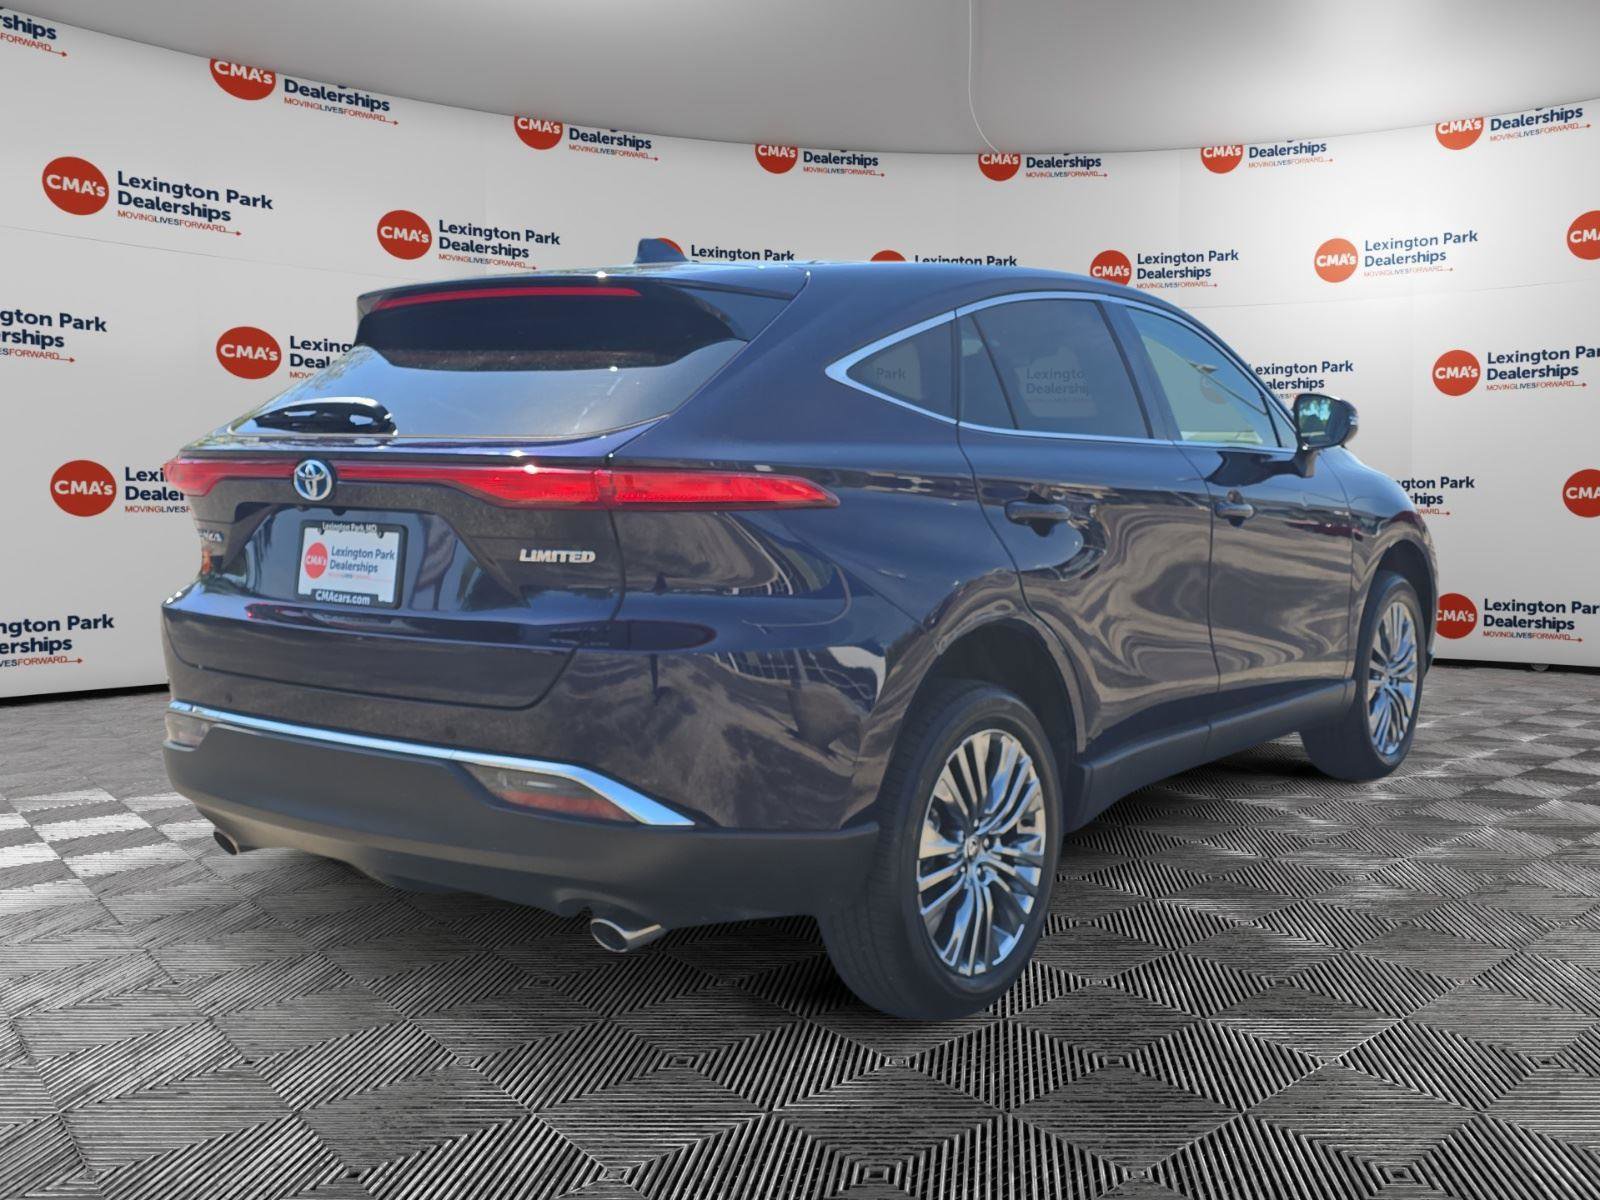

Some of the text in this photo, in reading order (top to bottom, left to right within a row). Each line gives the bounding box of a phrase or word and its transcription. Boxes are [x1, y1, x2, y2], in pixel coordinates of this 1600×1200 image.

[0, 14, 57, 40] ships
[213, 60, 273, 85] CMA's
[284, 78, 390, 112] Dealerships
[284, 97, 386, 122] MOVINGLIVESFORWARD
[517, 117, 560, 134] CMA's
[1437, 119, 1482, 135] CMA's
[1490, 107, 1583, 131] Dealerships
[569, 127, 652, 151] Dealerships
[1490, 122, 1580, 142] MOVINGLIVESFORWARD
[757, 145, 796, 158] CMA's
[1202, 145, 1242, 159] CMA's
[1248, 141, 1328, 159] Dealerships
[803, 151, 879, 168] Dealerships
[980, 153, 1019, 165] CMA's
[1026, 156, 1102, 170] Dealerships
[46, 174, 106, 197] CMA's
[117, 171, 273, 209] Lexington Park
[117, 190, 231, 222] Dealerships
[117, 210, 226, 233] MOVINGLIVESFORWARD
[380, 226, 430, 244] CMA's
[439, 219, 561, 245] Lexington Park
[1364, 230, 1478, 251] Lexington Park
[439, 236, 529, 260] Dealerships
[691, 244, 795, 261] Lexington Park
[438, 253, 526, 268] MOVINGLIVESFORWARD
[987, 255, 1017, 266] Park
[1137, 249, 1239, 266] Lexington Park
[1316, 253, 1356, 267] CMA's
[1364, 250, 1446, 267] Dealerships
[1092, 265, 1130, 277] CMA's
[1137, 266, 1212, 281] Dealerships
[60, 312, 107, 332] Park
[0, 329, 65, 349] rships
[220, 343, 278, 361] CMA's
[1487, 350, 1570, 365] Lexington
[876, 367, 907, 380] Park
[1322, 360, 1354, 373] Park
[1435, 365, 1479, 380] CMA's
[1486, 365, 1579, 380] Dealerships
[1486, 380, 1575, 391] MOVINGLIVESFORWARD
[125, 466, 168, 482] Lexi
[1440, 476, 1475, 488] Park
[54, 479, 113, 496] CMA's
[322, 521, 350, 533] Lexington
[331, 545, 395, 560] Lexington Park
[519, 548, 596, 563] LIMITED
[329, 559, 378, 574] Dealerships
[315, 590, 370, 605] CMAcars.com
[1484, 598, 1566, 615] Lexington
[67, 614, 114, 630] Park
[1436, 609, 1475, 622] CMA's
[1483, 614, 1575, 632] Dealerships
[1483, 630, 1570, 641] MOVINGLIVESFORWARD
